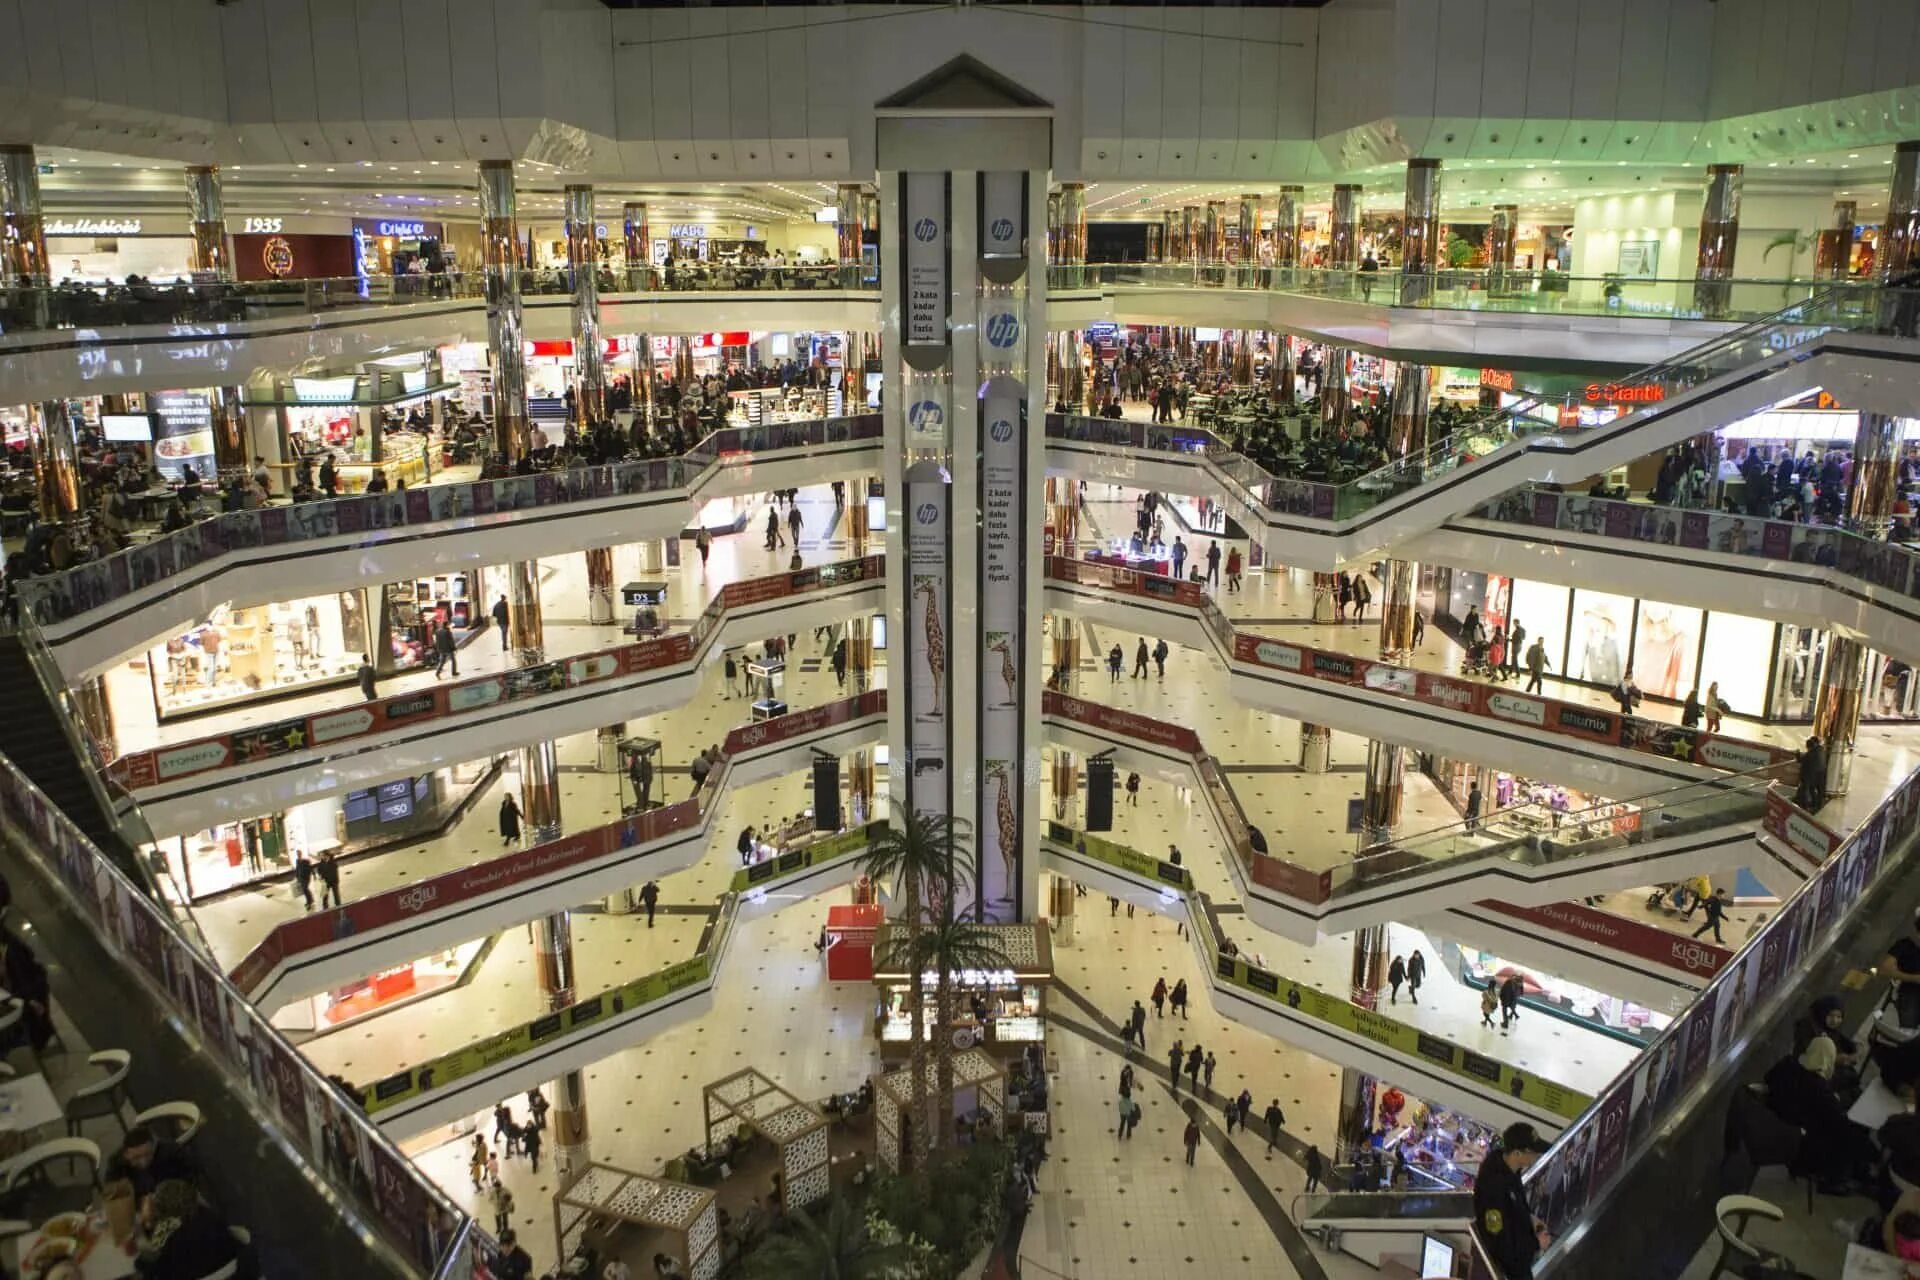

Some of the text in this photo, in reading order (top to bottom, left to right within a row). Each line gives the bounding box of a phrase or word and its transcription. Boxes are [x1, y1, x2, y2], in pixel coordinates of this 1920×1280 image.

[244, 217, 282, 233] 1935
[915, 217, 938, 242] hp
[992, 219, 1014, 242] hp
[986, 312, 1019, 348] hp
[991, 420, 1013, 443] hp
[916, 503, 938, 525] hp
